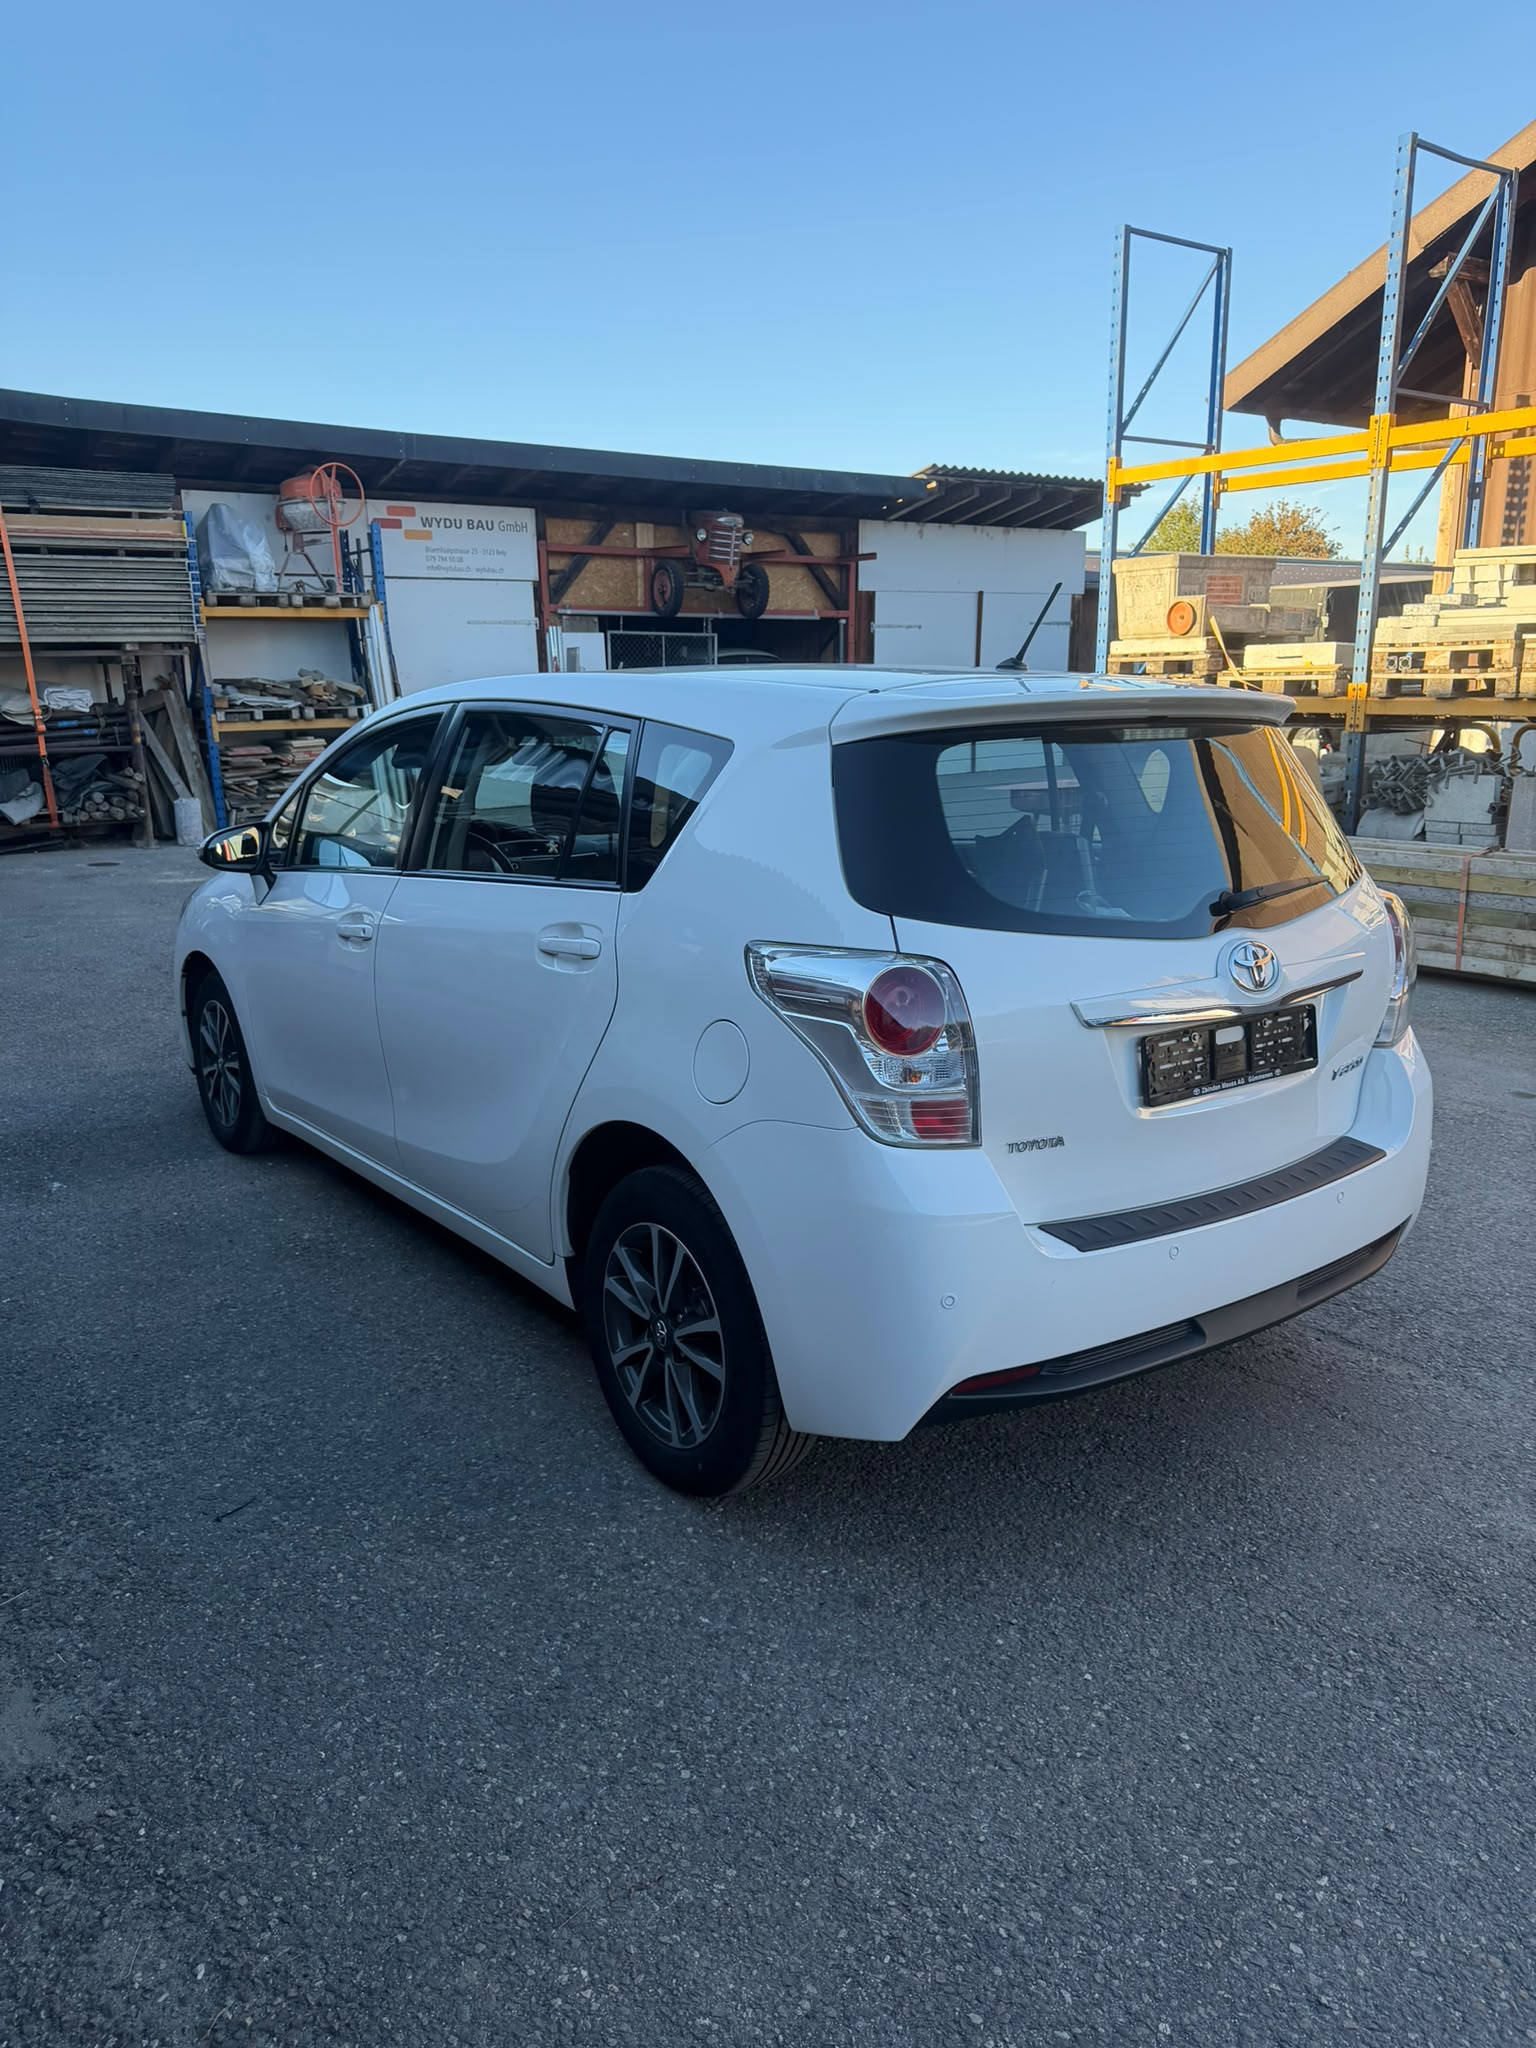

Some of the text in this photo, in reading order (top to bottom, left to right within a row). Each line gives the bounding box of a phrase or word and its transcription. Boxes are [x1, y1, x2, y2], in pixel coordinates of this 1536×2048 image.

[420, 516, 528, 533] WYDU BAU GmbH
[1237, 1077, 1245, 1085] AG
[1007, 1135, 1065, 1154] TOYOTA
